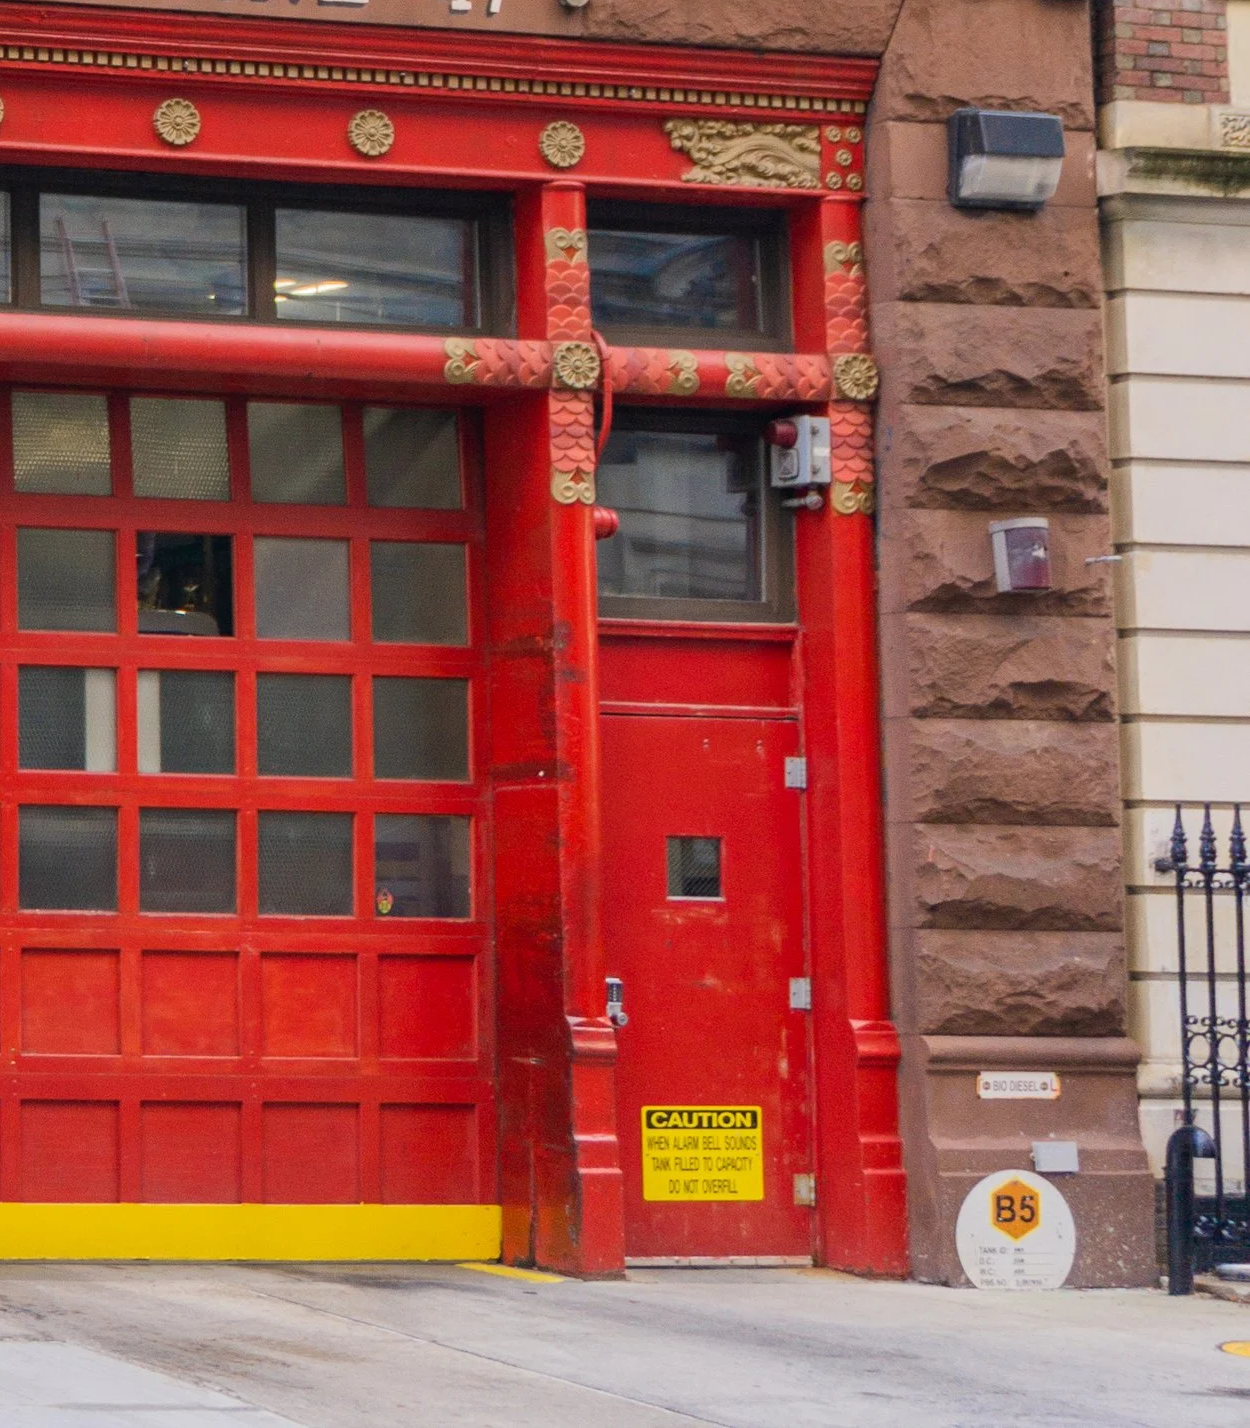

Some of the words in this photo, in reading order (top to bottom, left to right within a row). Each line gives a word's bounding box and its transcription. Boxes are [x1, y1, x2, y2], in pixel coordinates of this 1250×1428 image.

[993, 1081, 1007, 1092] BIO
[1009, 1081, 1038, 1092] DIESEL
[651, 1112, 752, 1128] CAUTION
[647, 1136, 670, 1150] WHEN
[673, 1136, 699, 1150] ALARM
[703, 1136, 721, 1150] BELL
[725, 1136, 757, 1150] SOUNDS
[652, 1157, 670, 1171] TANK
[674, 1157, 699, 1171] FILLED
[703, 1157, 713, 1171] TO
[716, 1157, 753, 1171] CAPACITY
[669, 1179, 679, 1193] DO
[683, 1179, 699, 1193] NOT
[702, 1179, 738, 1193] OVERFILL
[996, 1195, 1036, 1223] B5
